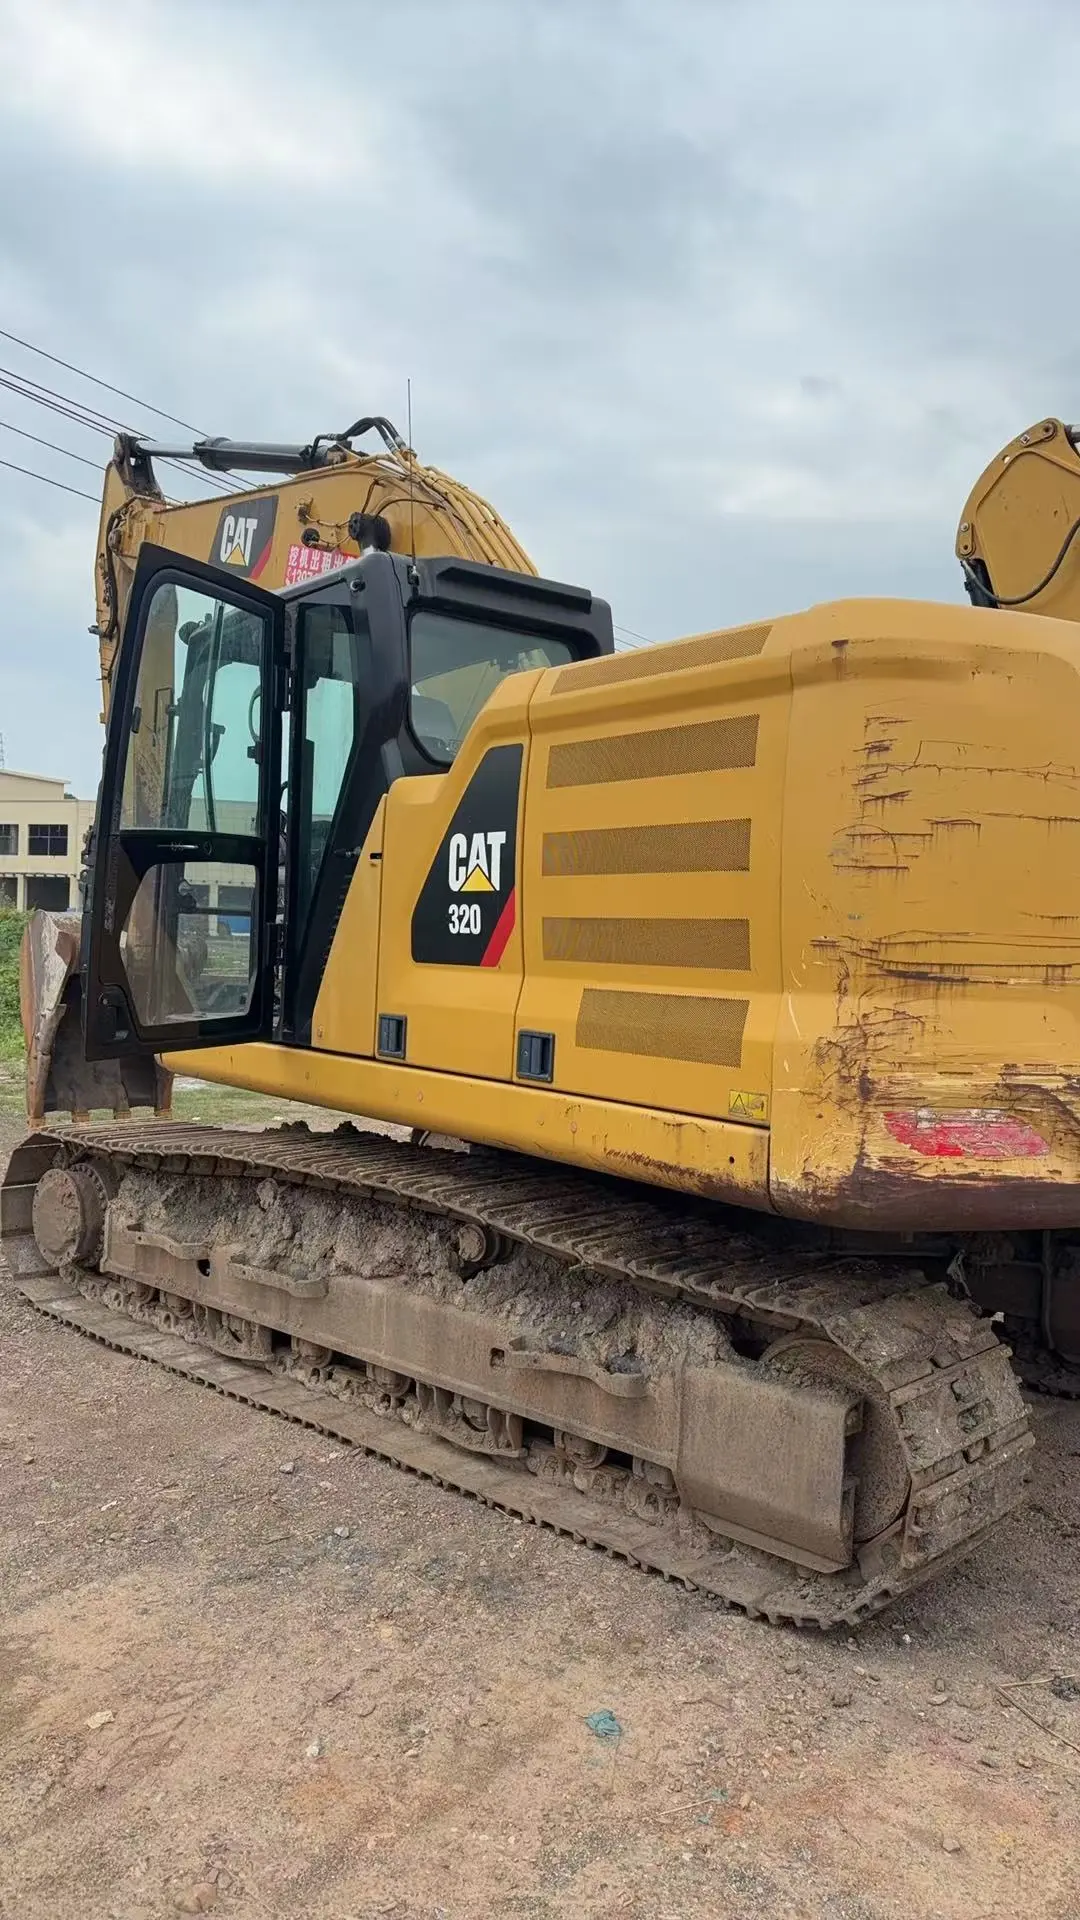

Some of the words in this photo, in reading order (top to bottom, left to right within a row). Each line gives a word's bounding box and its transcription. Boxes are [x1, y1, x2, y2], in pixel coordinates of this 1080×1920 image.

[220, 515, 258, 567] CAT
[448, 831, 507, 892] CAT
[448, 903, 481, 935] 320
